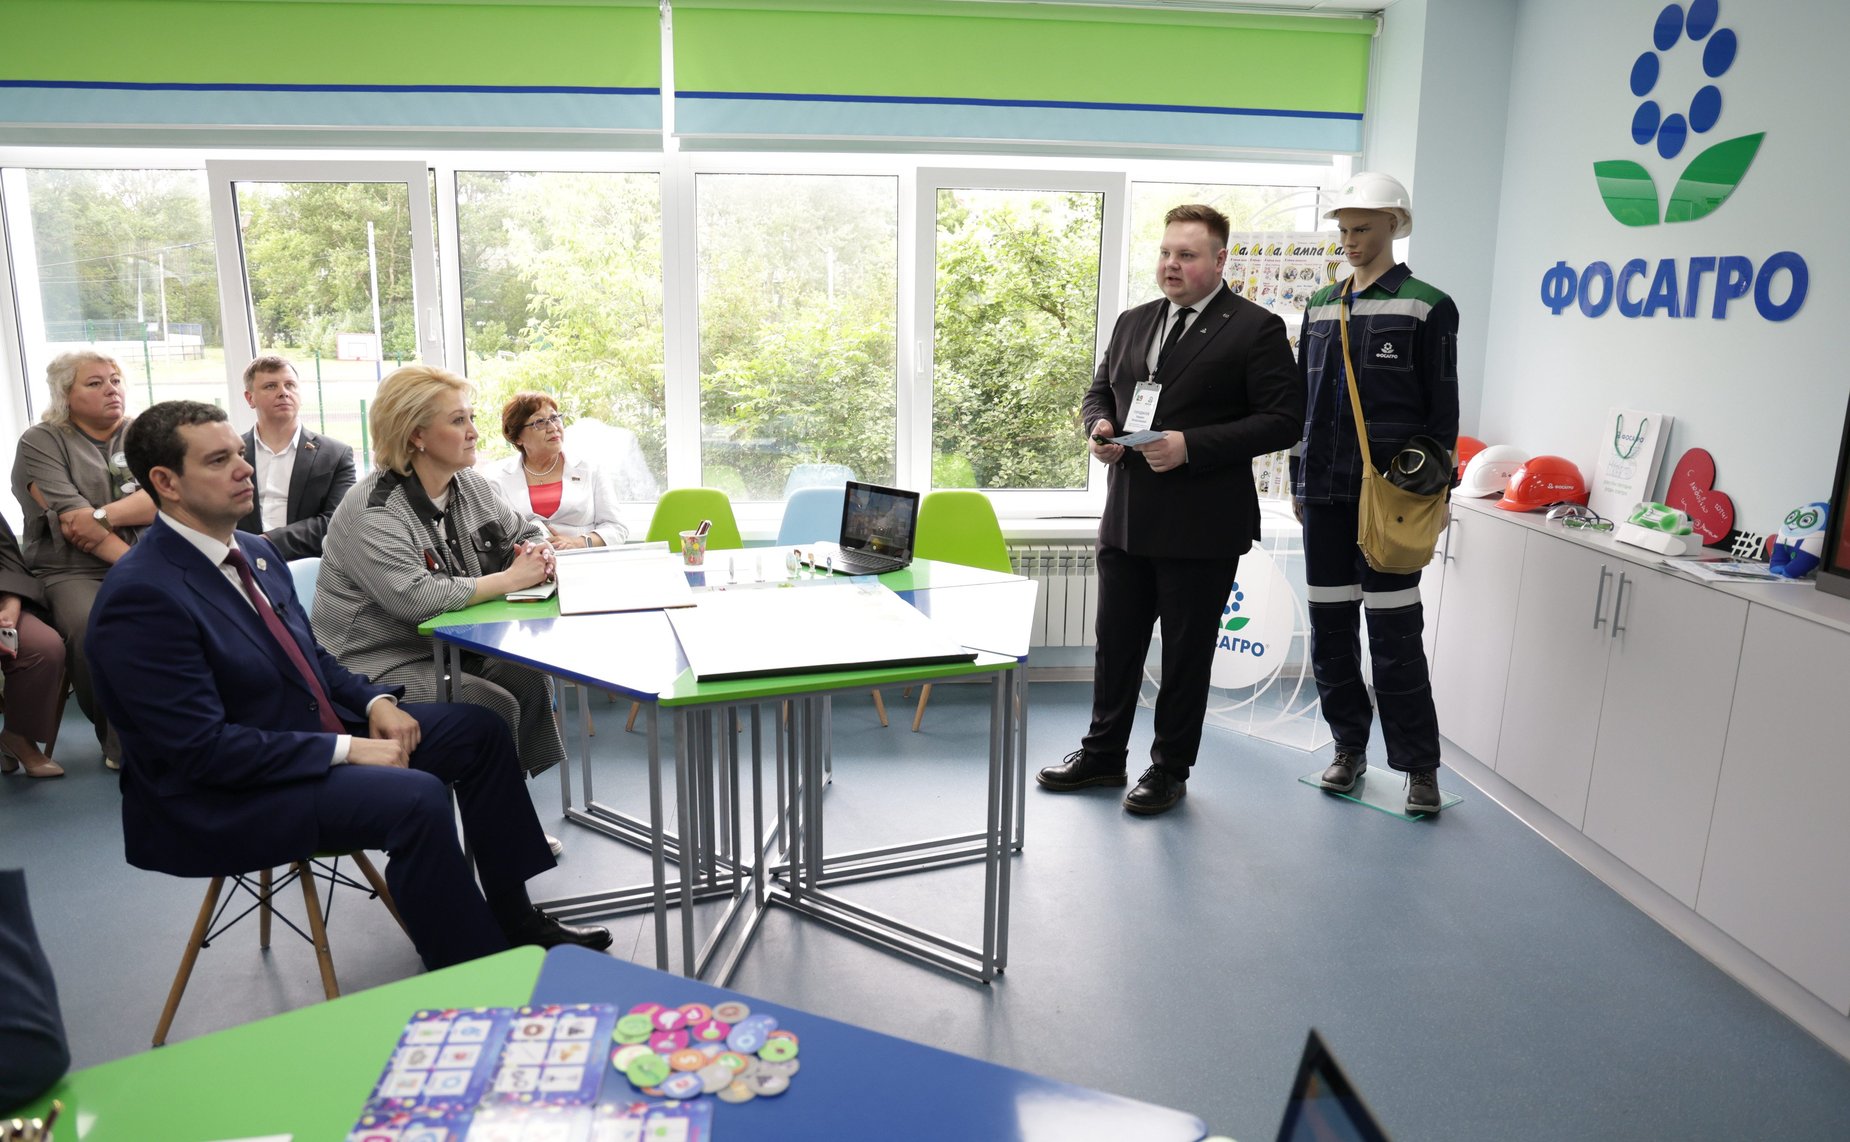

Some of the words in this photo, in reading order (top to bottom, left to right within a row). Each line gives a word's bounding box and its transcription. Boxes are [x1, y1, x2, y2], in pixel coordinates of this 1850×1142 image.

[1230, 242, 1248, 256] Ла
[1265, 243, 1282, 256] Ла
[1284, 242, 1325, 256] Лампа
[1326, 242, 1345, 256] Ла
[1541, 251, 1809, 322] ФОСАГРО
[1216, 634, 1265, 657] АГРО
